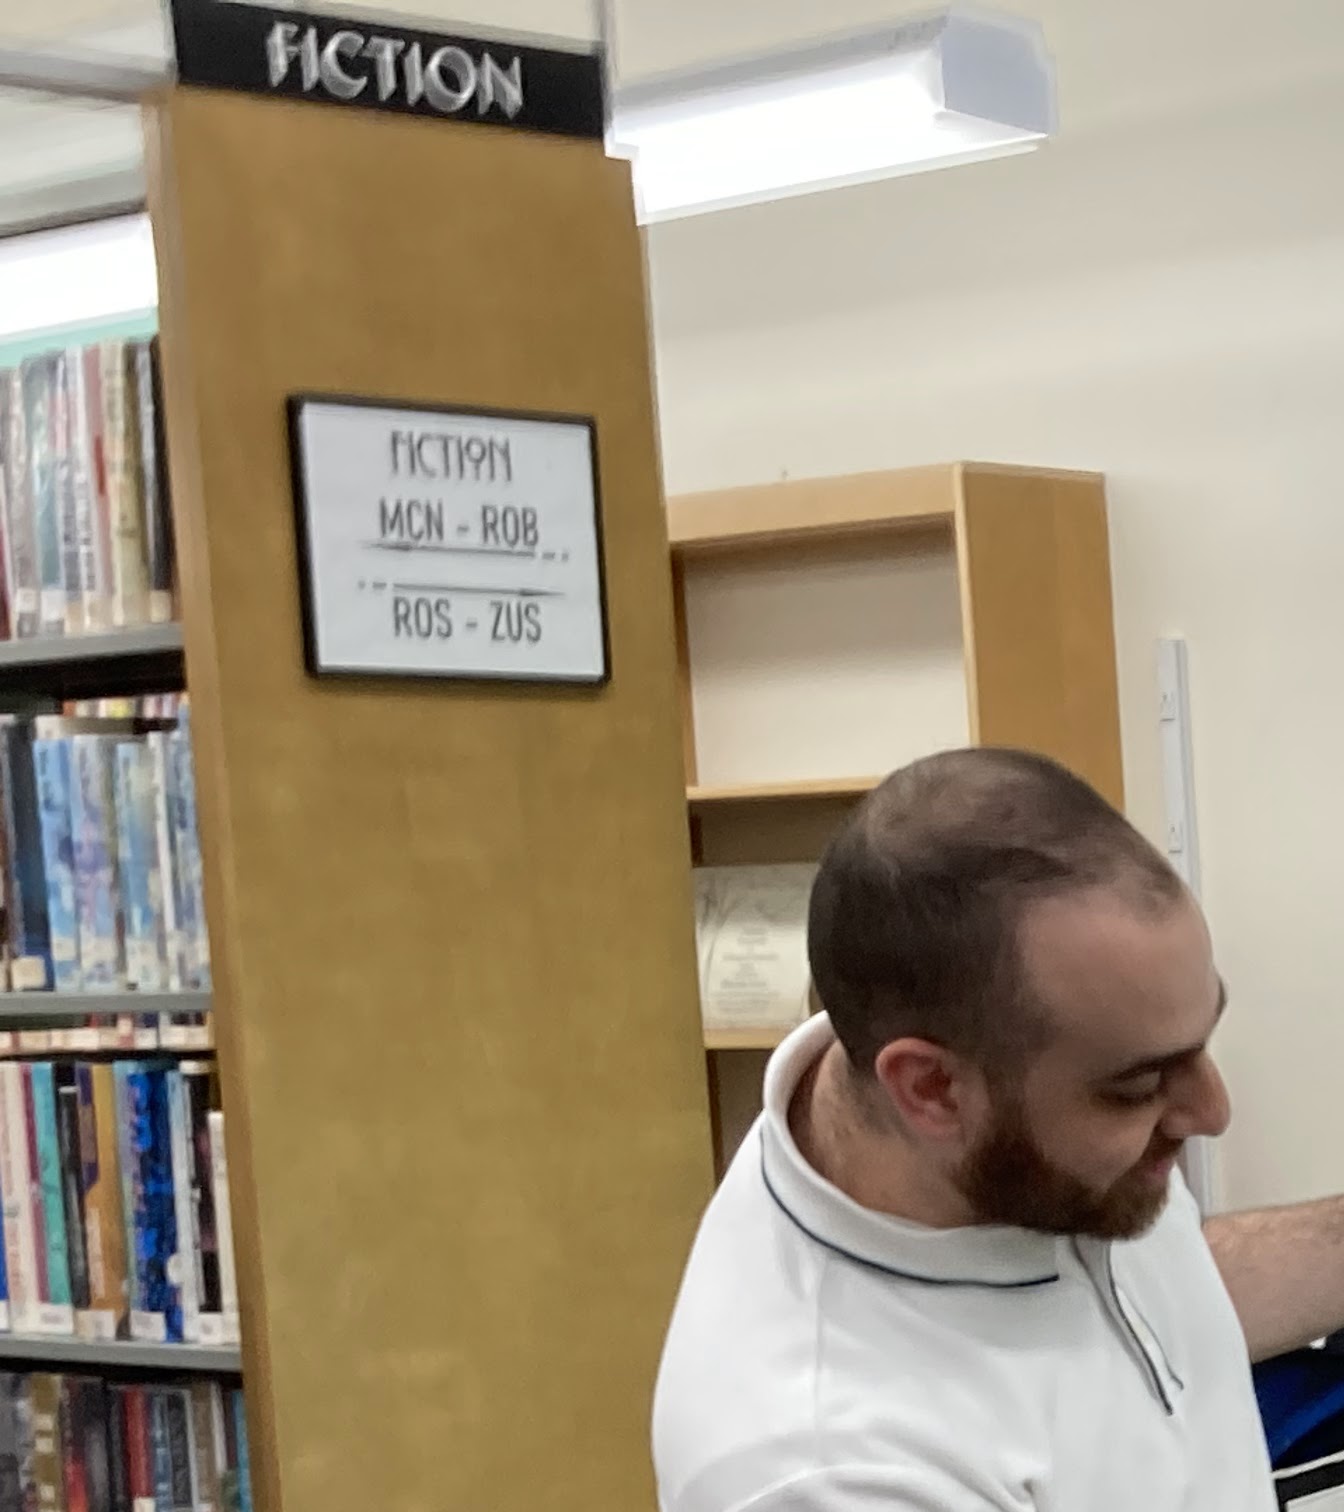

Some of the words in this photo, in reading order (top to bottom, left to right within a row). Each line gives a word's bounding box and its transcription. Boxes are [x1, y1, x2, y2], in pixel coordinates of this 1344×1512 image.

[267, 20, 523, 120] FICTION
[391, 430, 513, 483] FICTION
[379, 497, 445, 542] MCN
[482, 504, 539, 547] ROB
[393, 596, 453, 639] ROS
[490, 600, 543, 644] ZUS
